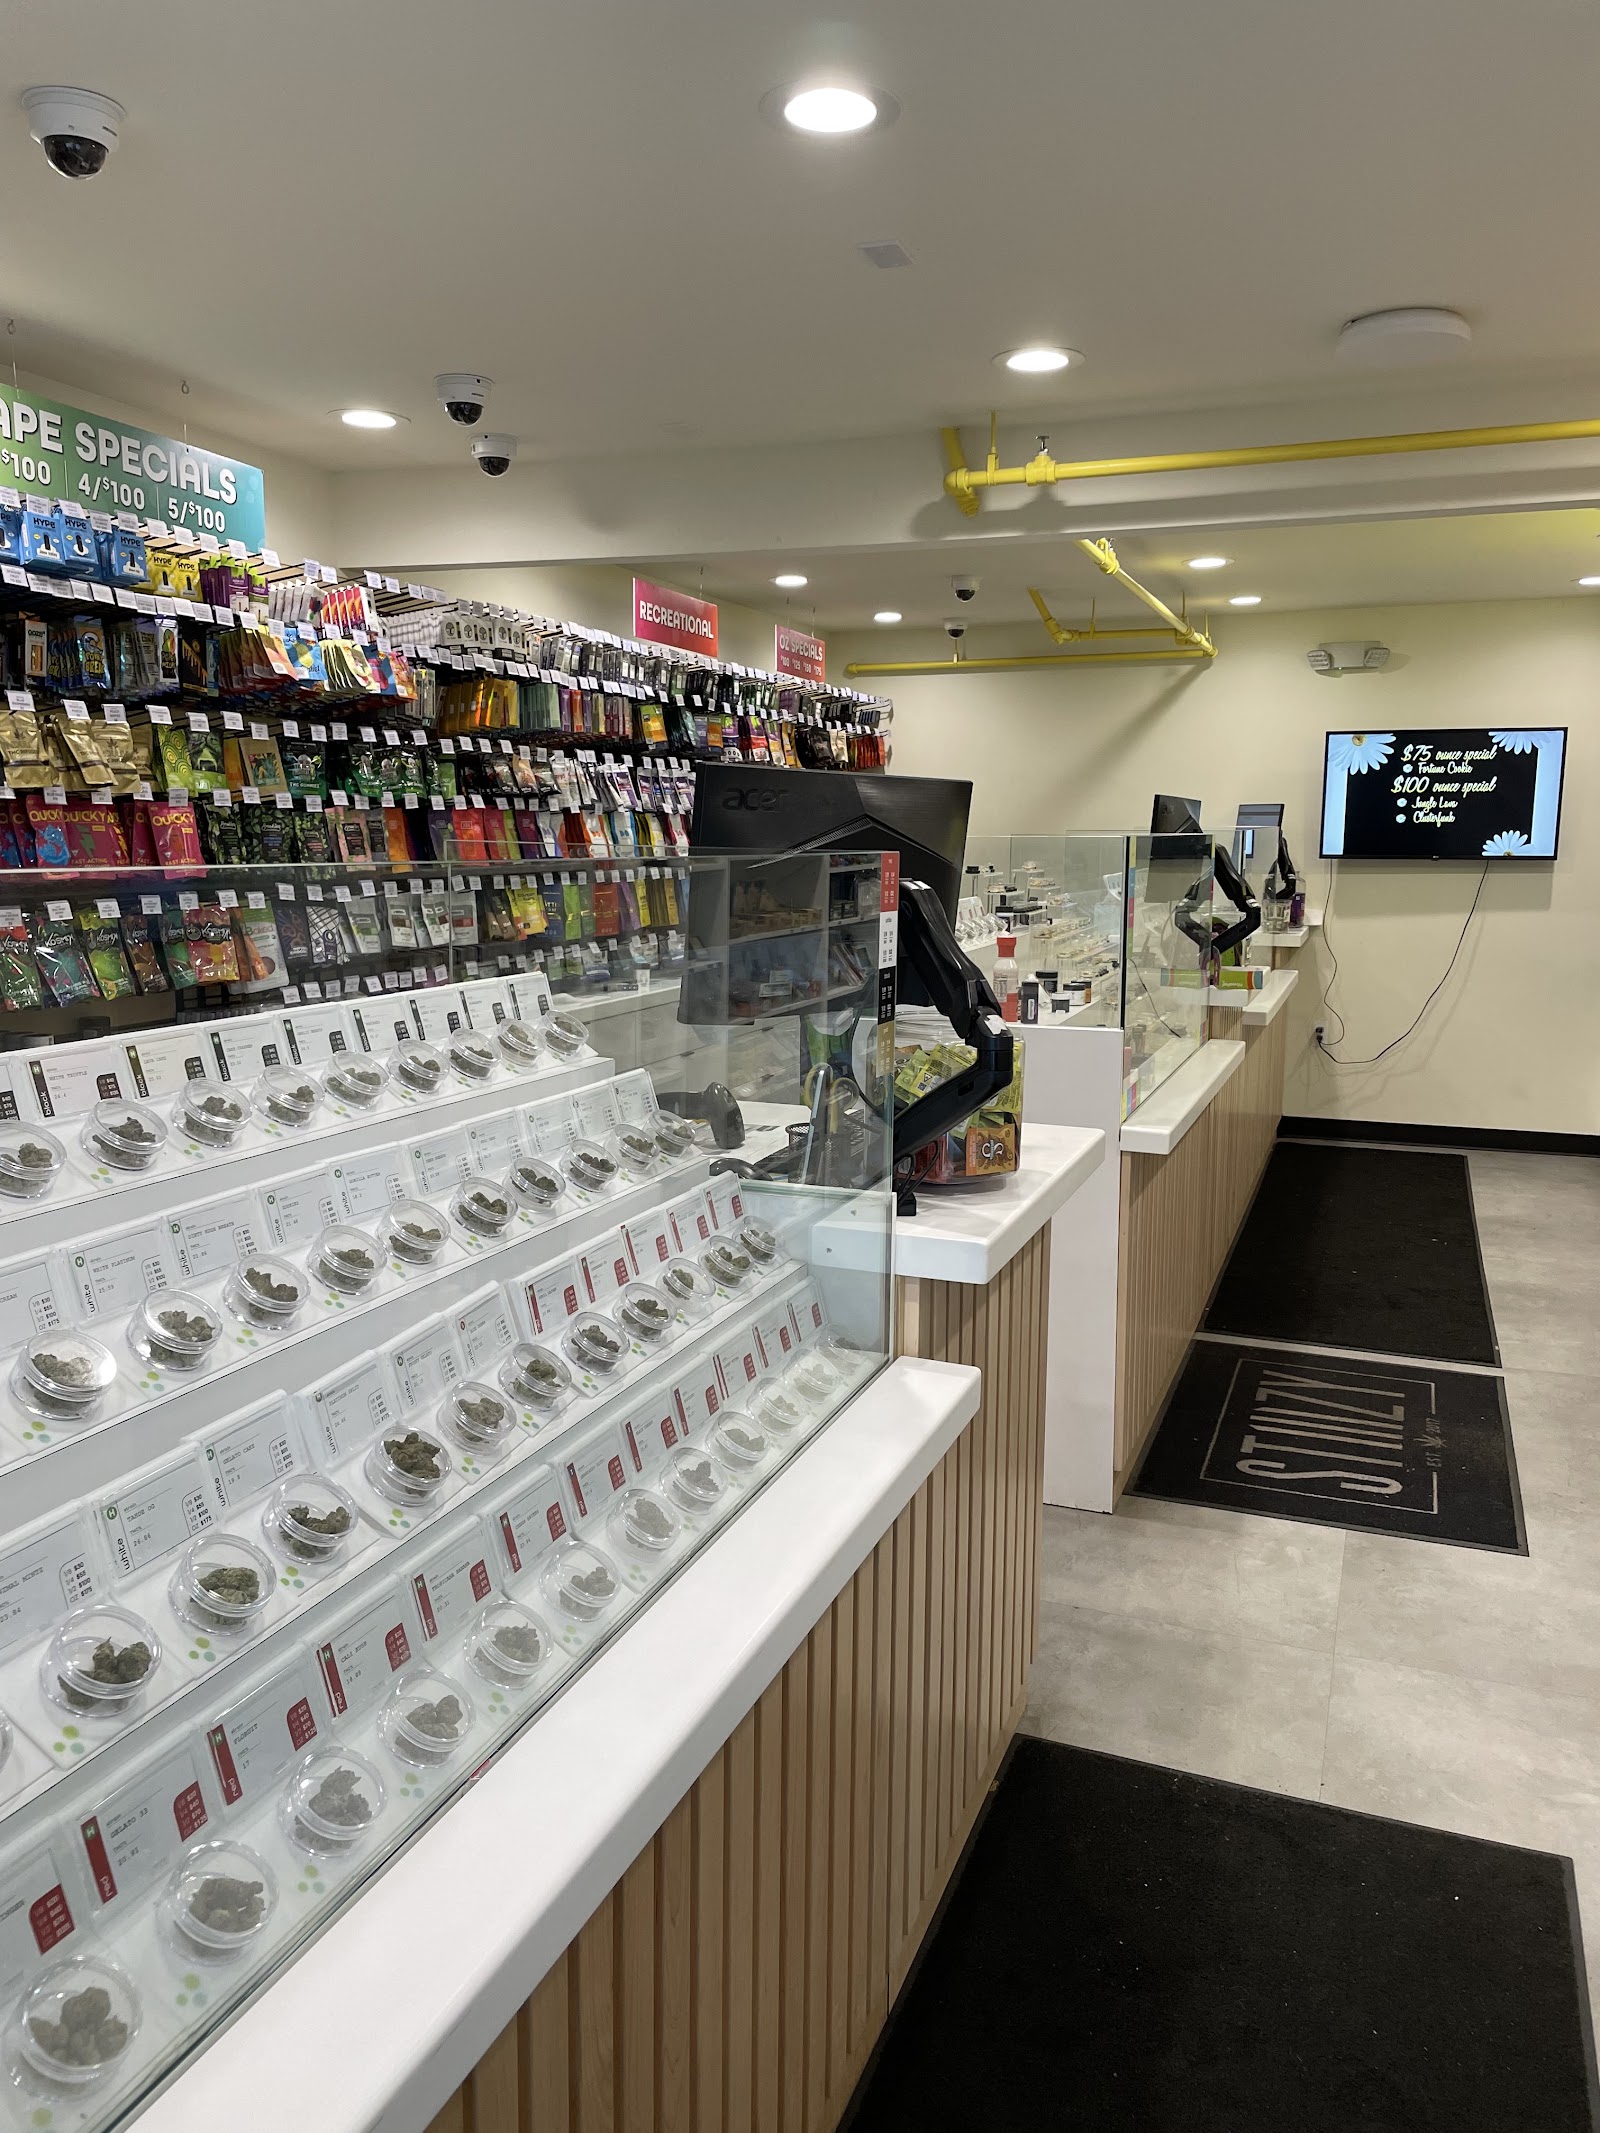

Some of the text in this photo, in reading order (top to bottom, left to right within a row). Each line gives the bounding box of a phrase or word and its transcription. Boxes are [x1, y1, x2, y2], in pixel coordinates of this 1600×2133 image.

[75, 422, 237, 505] SPECIALS
[78, 473, 145, 510] 4/$100
[168, 497, 225, 533] 5/$100
[639, 600, 714, 639] RECREATIONAL
[780, 634, 823, 662] OZ SPECIALS
[1400, 743, 1498, 765] $75 ounce special
[1418, 760, 1473, 774] Fortune Cookie
[1390, 774, 1498, 798] $100 ounce special
[722, 788, 791, 811] acer
[1411, 796, 1437, 813] Jungle
[219, 1059, 229, 1080] black
[136, 1074, 147, 1097] black
[40, 1091, 52, 1116] black
[180, 1249, 191, 1275] white
[84, 1284, 96, 1313] white
[325, 1426, 337, 1454] white
[214, 1477, 226, 1507] white
[147, 1503, 155, 1512] OG
[198, 1508, 209, 1518] $100
[200, 1515, 212, 1526] $175
[117, 1538, 131, 1571] white
[73, 1562, 84, 1571] $30
[78, 1577, 91, 1588] $100
[80, 1586, 93, 1597] $175
[427, 1618, 435, 1634] red
[298, 1704, 307, 1714] $20
[335, 1691, 344, 1709] red
[300, 1712, 309, 1722] $40
[302, 1721, 312, 1730] $70
[304, 1726, 317, 1739] $125
[228, 1777, 239, 1797] red
[139, 1807, 148, 1818] 33
[99, 1875, 114, 1898] red
